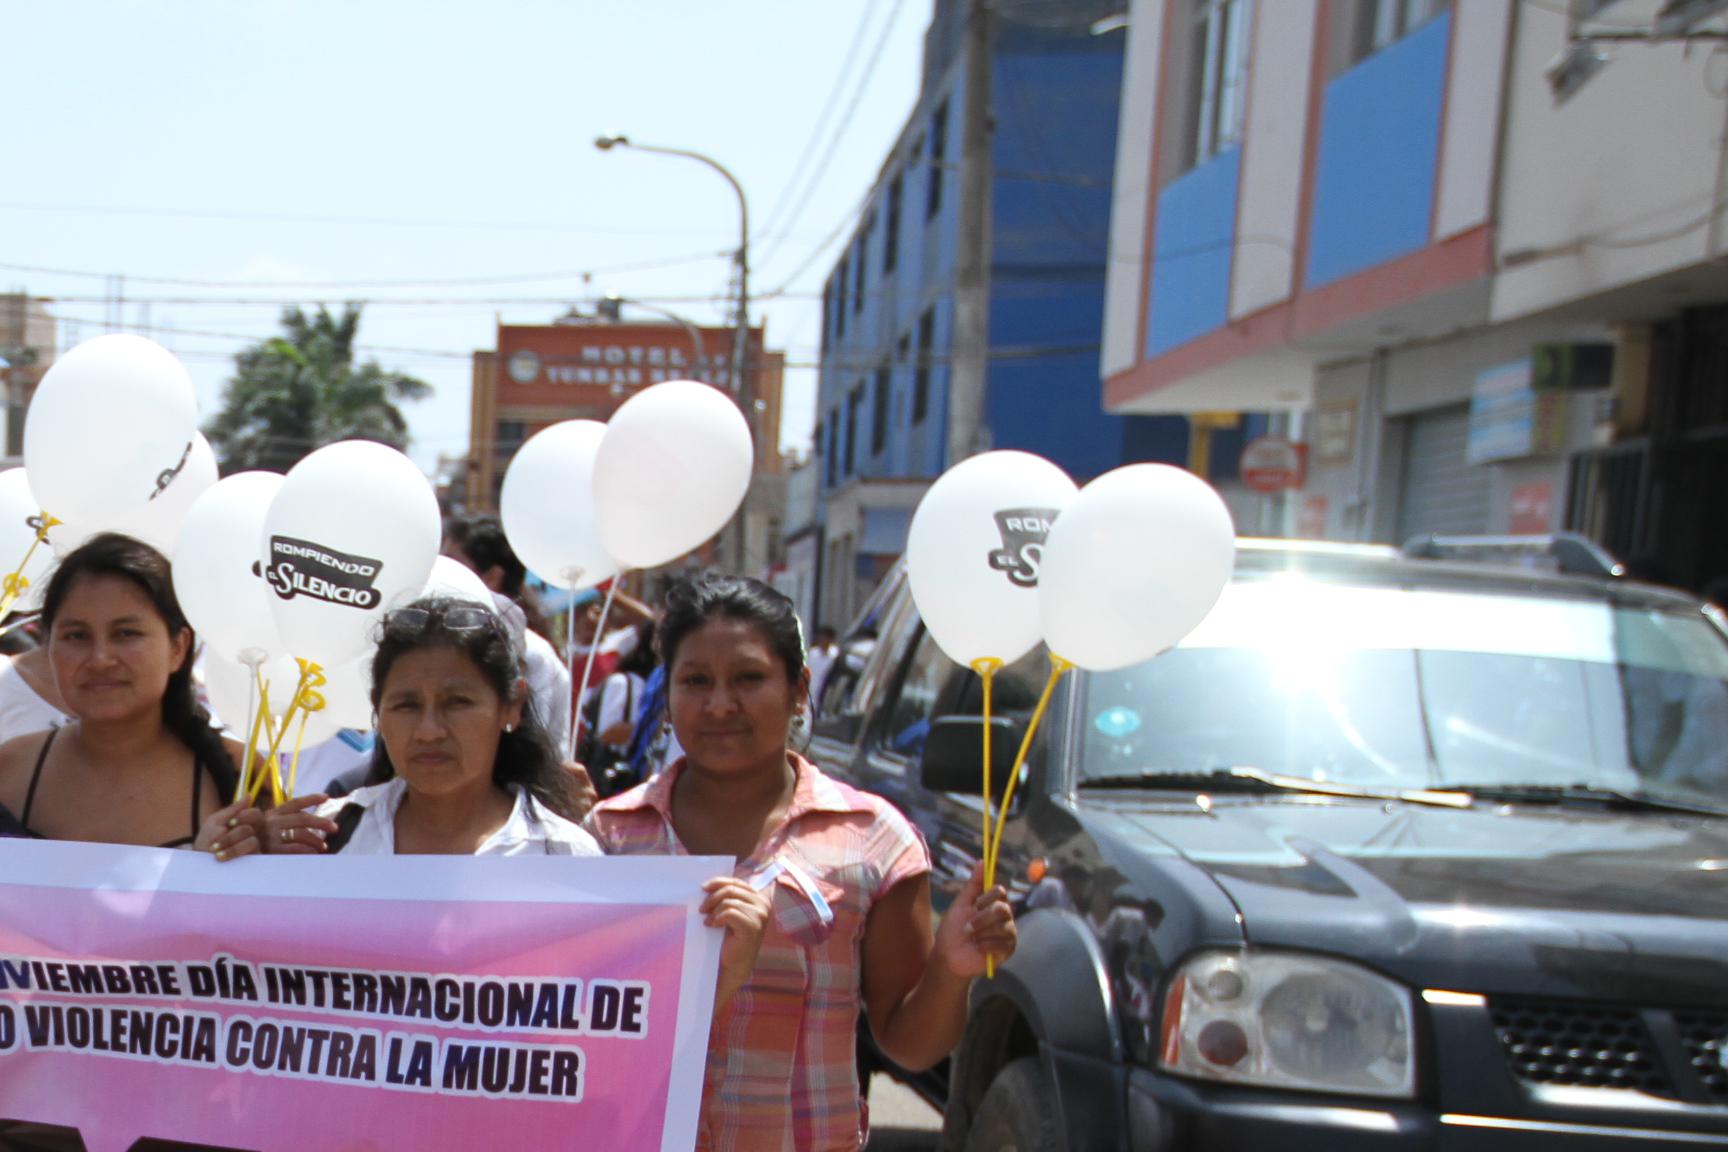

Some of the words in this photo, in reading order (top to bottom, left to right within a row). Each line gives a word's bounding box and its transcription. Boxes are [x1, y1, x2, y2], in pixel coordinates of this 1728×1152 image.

[273, 542, 374, 577] ROMPIENDO
[997, 556, 1019, 566] EL
[275, 562, 372, 606] SILENCIO
[187, 955, 259, 1001] DÍA
[263, 966, 580, 1030] INTERNACIONAL
[590, 984, 645, 1033] DE
[24, 1004, 217, 1063] VIOLENCIA
[225, 1018, 376, 1082] CONTRA
[385, 1037, 433, 1088] LA
[442, 1043, 580, 1097] MUJER
